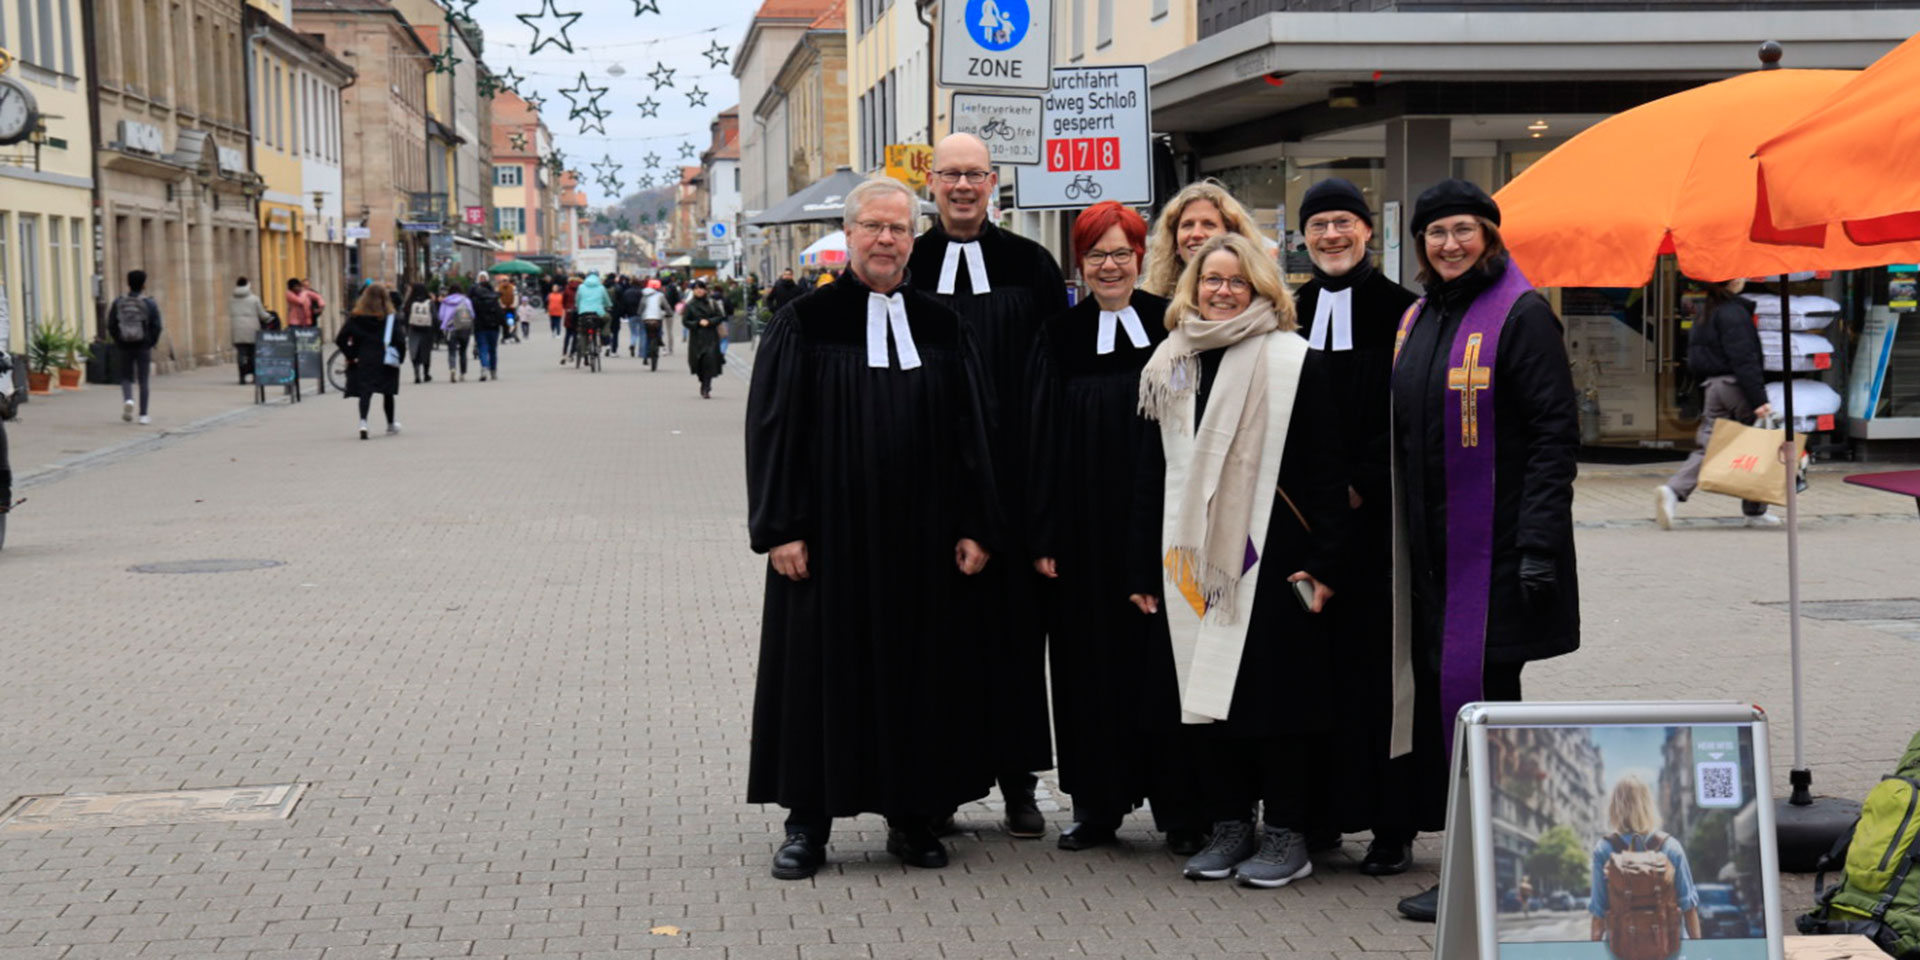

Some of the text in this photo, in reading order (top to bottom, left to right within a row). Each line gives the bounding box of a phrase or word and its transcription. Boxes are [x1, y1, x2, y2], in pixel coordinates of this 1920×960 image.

[968, 57, 1022, 78] ZONE
[1052, 71, 1119, 89] urchfahrt
[1045, 90, 1136, 114] dweg Schloß
[1017, 126, 1035, 137] frei
[1053, 113, 1114, 135] gesperrt
[1053, 141, 1114, 169] 6 7 8
